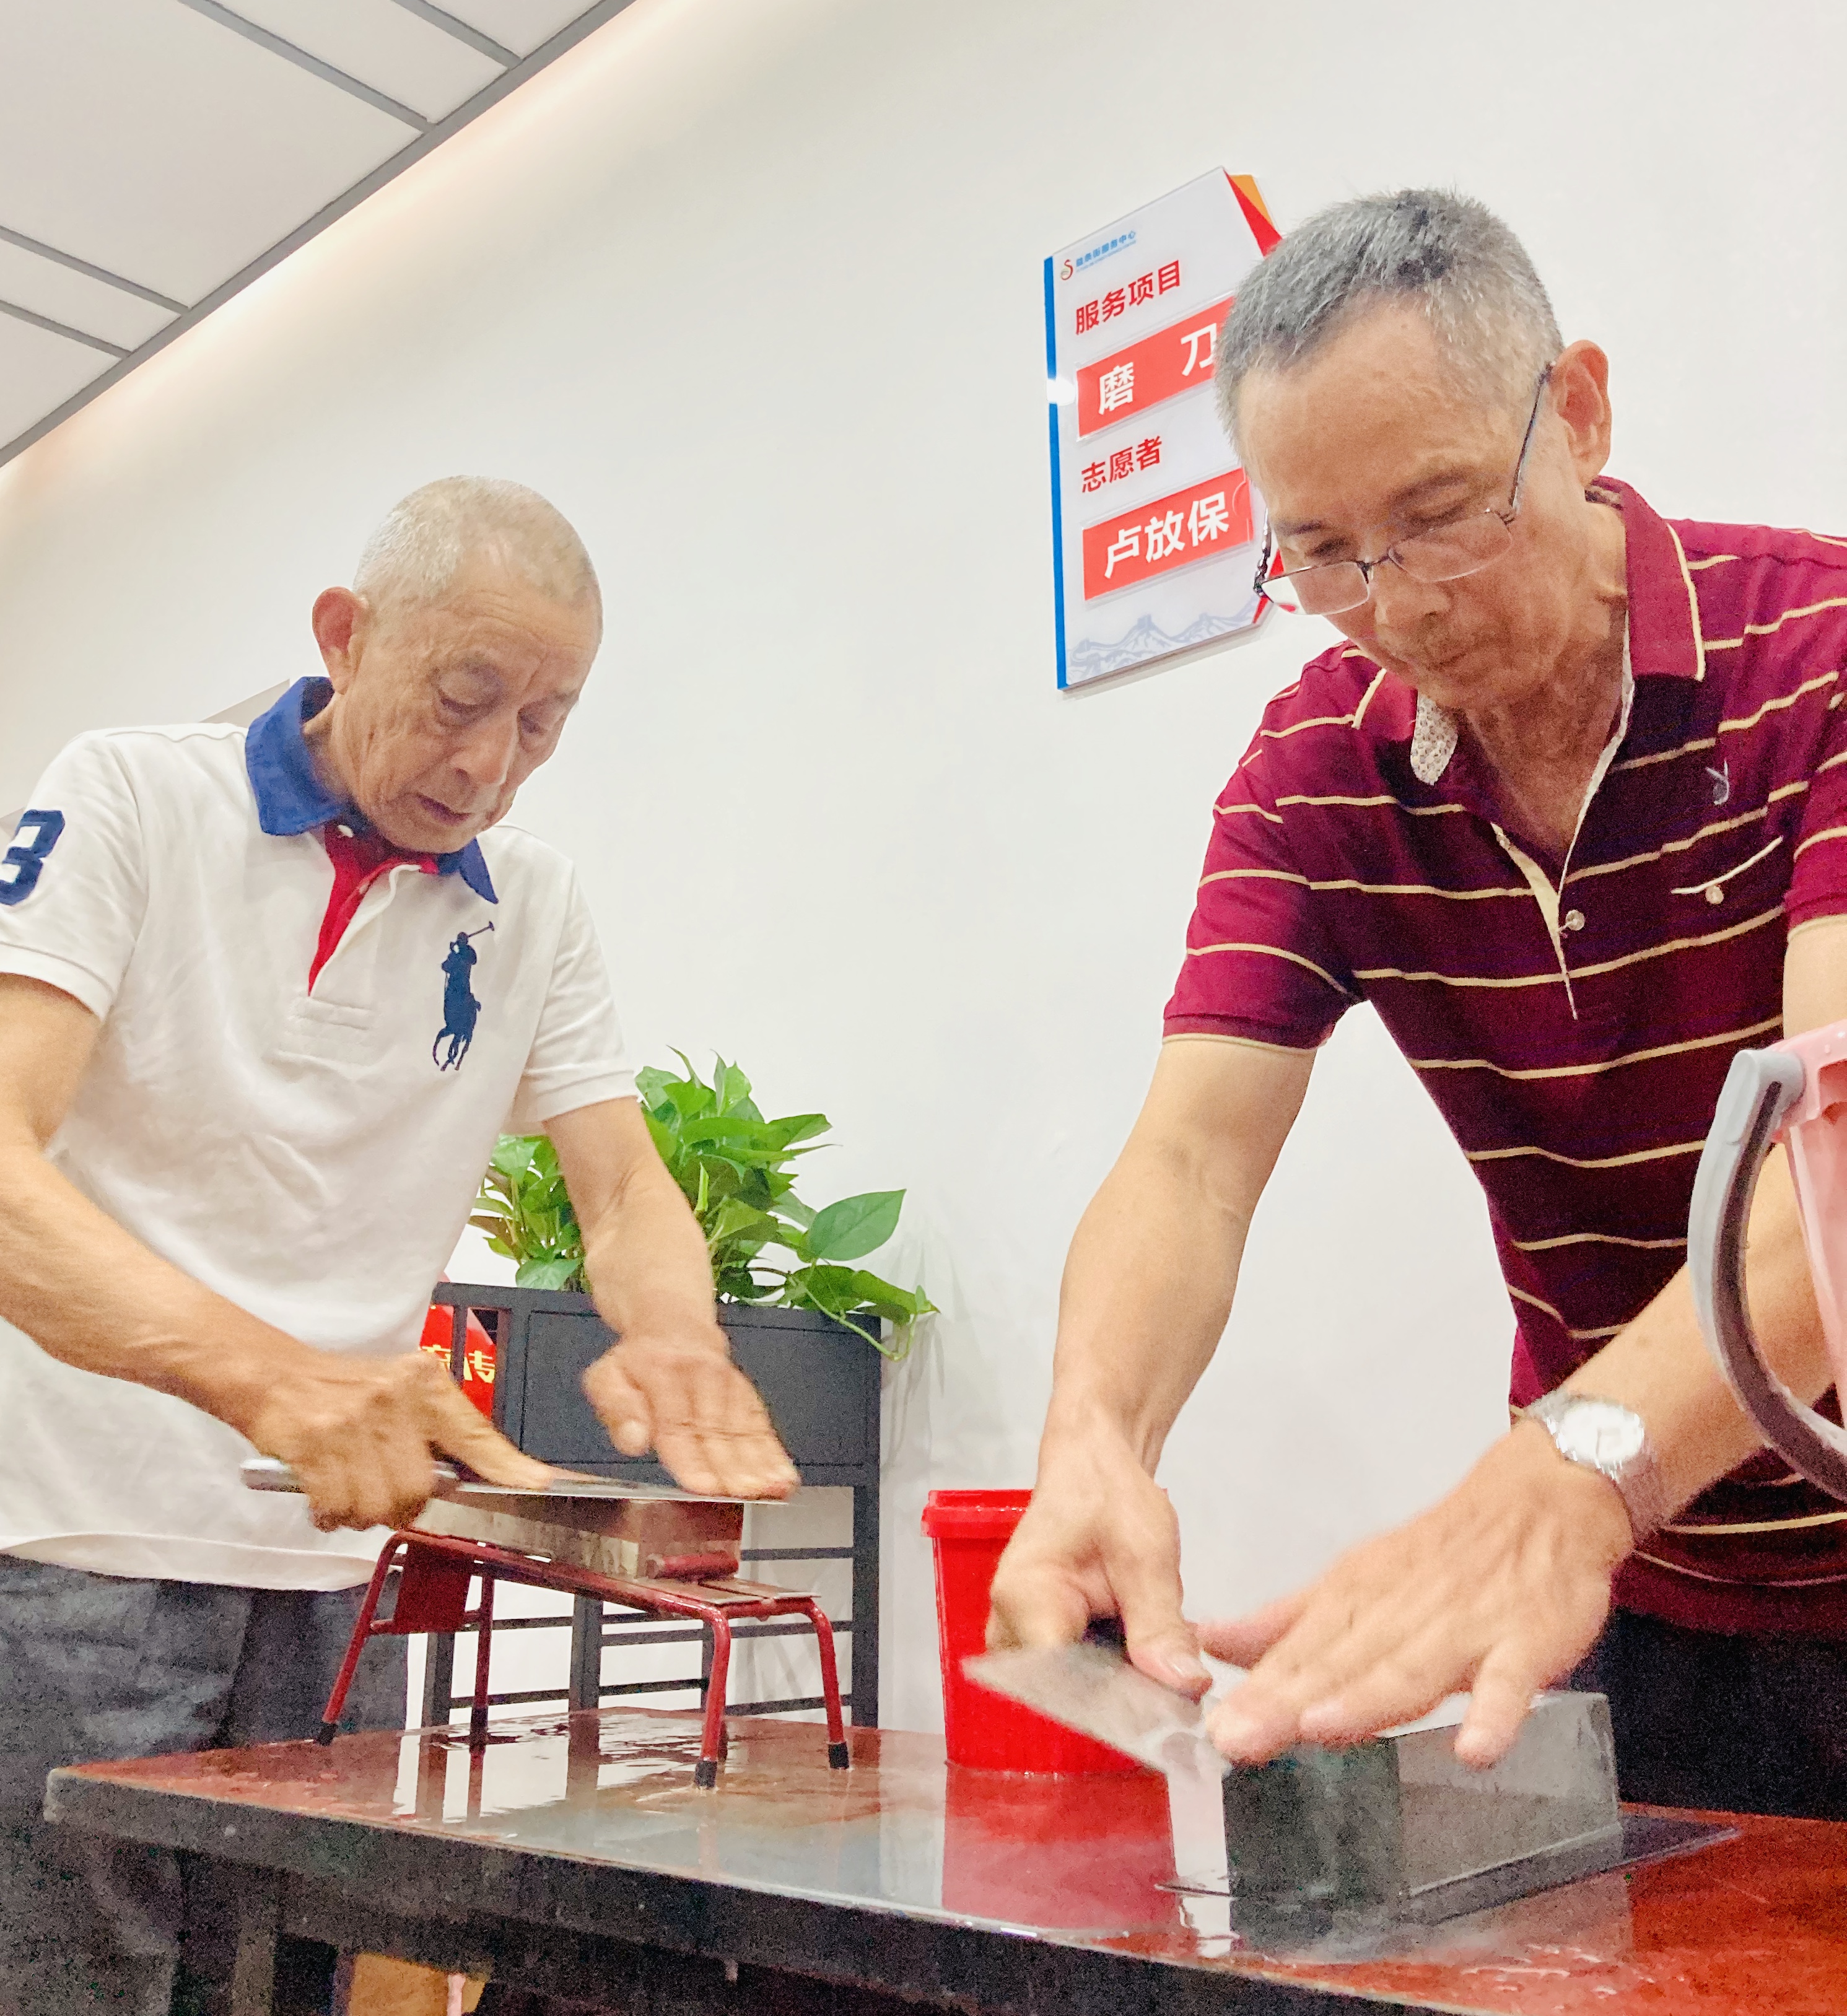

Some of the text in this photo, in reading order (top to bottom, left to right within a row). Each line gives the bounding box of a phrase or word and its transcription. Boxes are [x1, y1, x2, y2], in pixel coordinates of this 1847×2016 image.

[1075, 260, 1181, 335] 服务项目
[1081, 435, 1162, 494] 志愿者
[1104, 491, 1229, 578] 卢放保
[0, 809, 66, 907] 3
